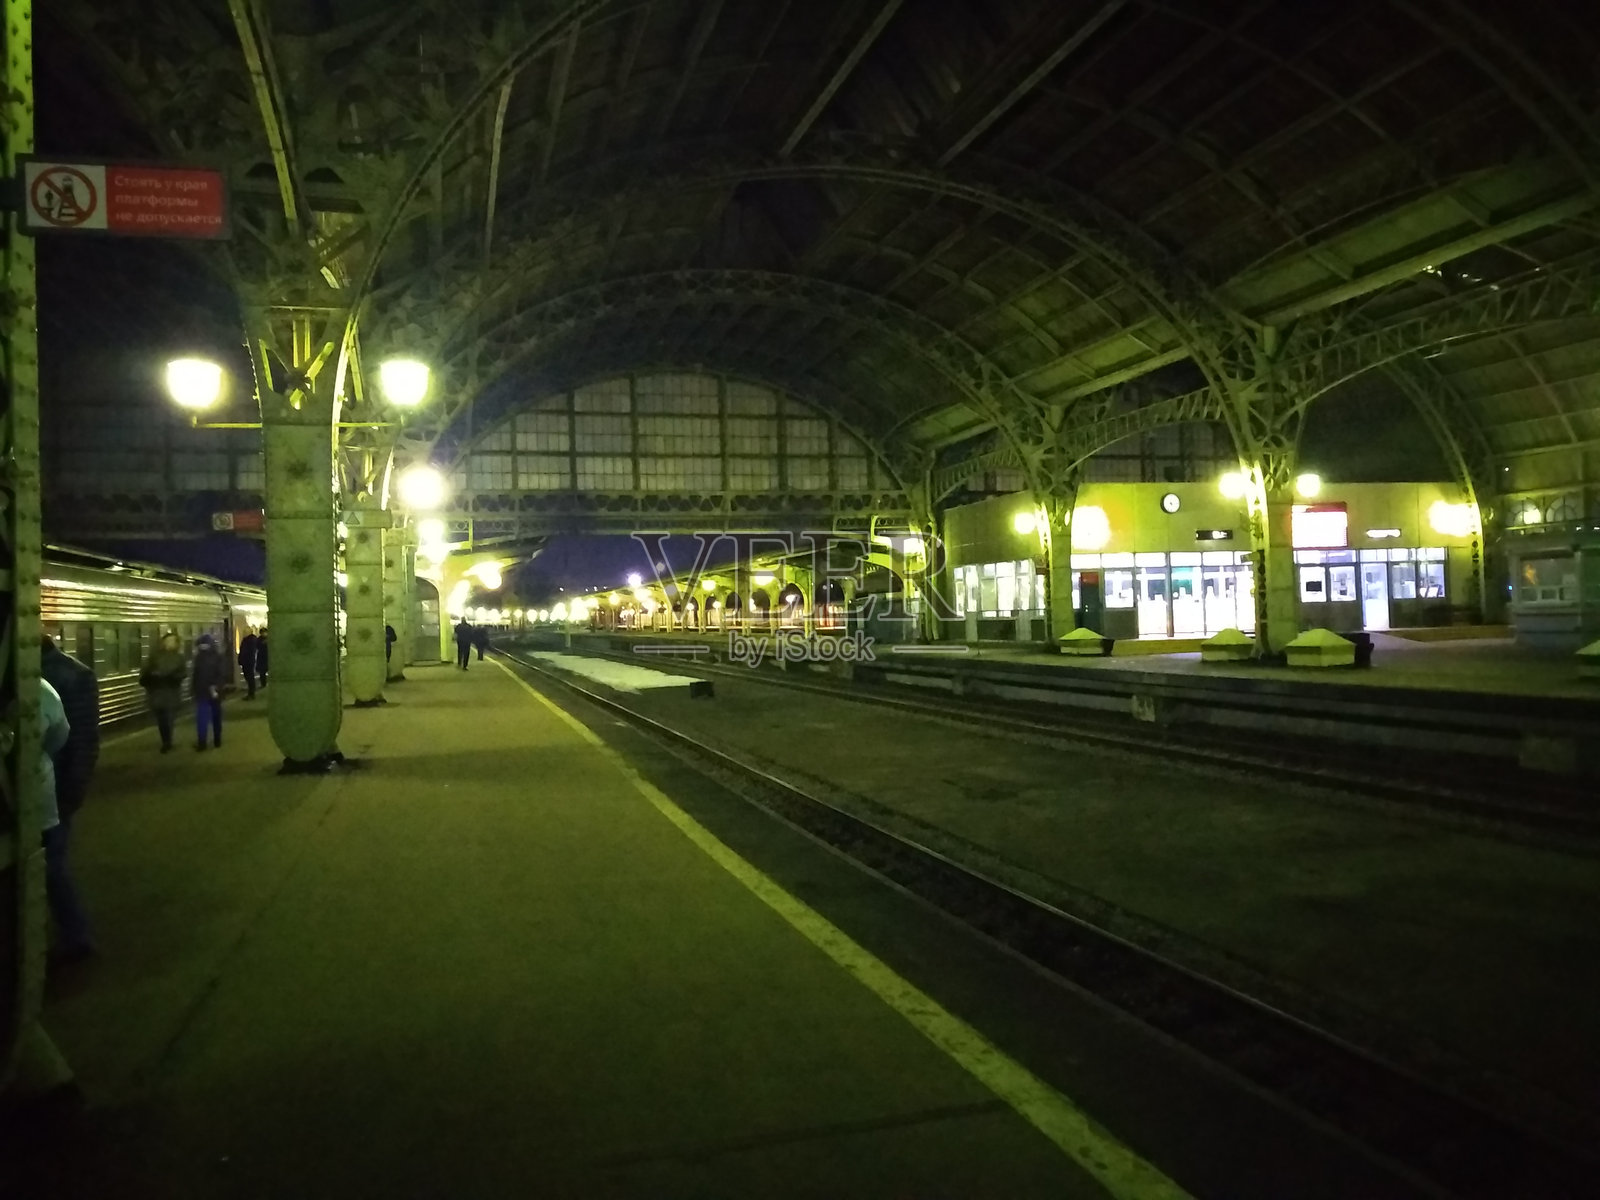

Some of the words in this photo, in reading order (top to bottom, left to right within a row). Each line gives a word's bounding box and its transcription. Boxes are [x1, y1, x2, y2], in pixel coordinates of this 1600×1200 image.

[114, 175, 161, 188] Стоять
[165, 179, 173, 191] у
[176, 180, 208, 192] края
[115, 194, 198, 207] платформы
[116, 213, 133, 221] не
[136, 213, 222, 225] допускается
